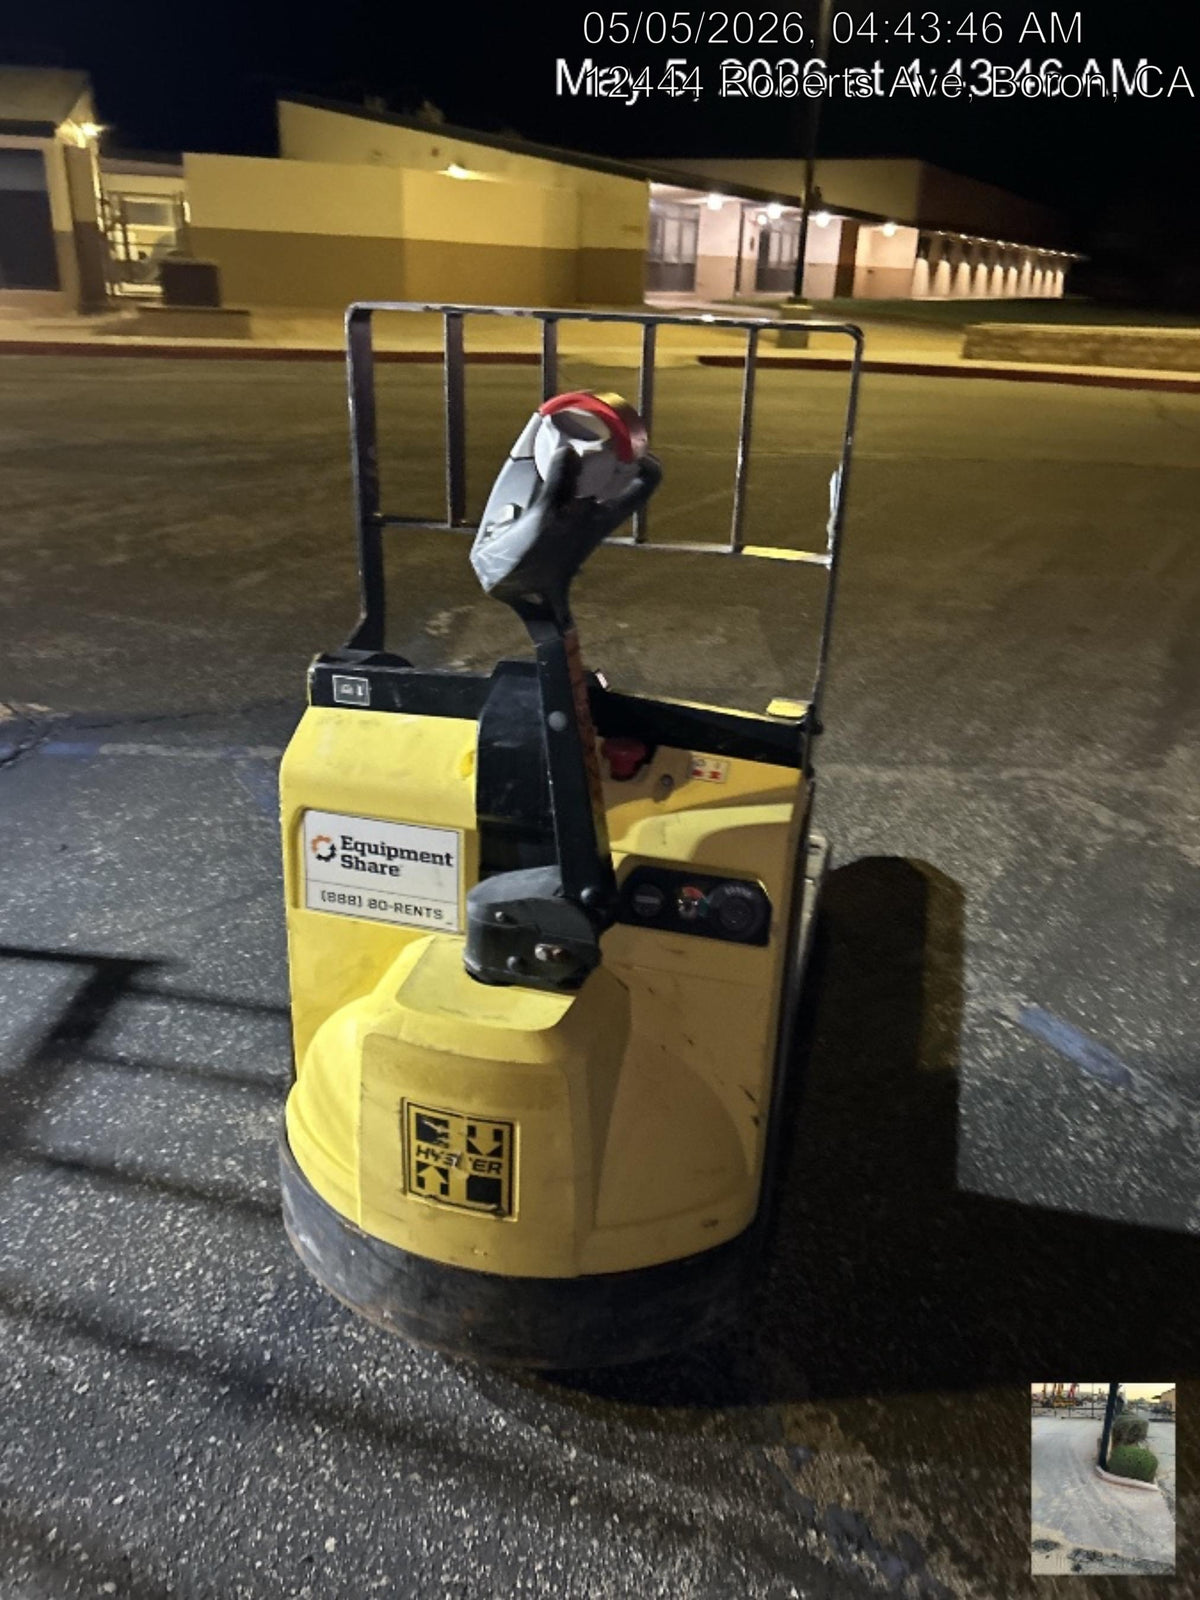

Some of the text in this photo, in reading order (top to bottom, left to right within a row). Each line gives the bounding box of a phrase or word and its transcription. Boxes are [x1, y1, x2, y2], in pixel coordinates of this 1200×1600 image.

[340, 835, 455, 867] Equipment
[340, 854, 401, 877] Share
[367, 898, 444, 920] 80-RENTS
